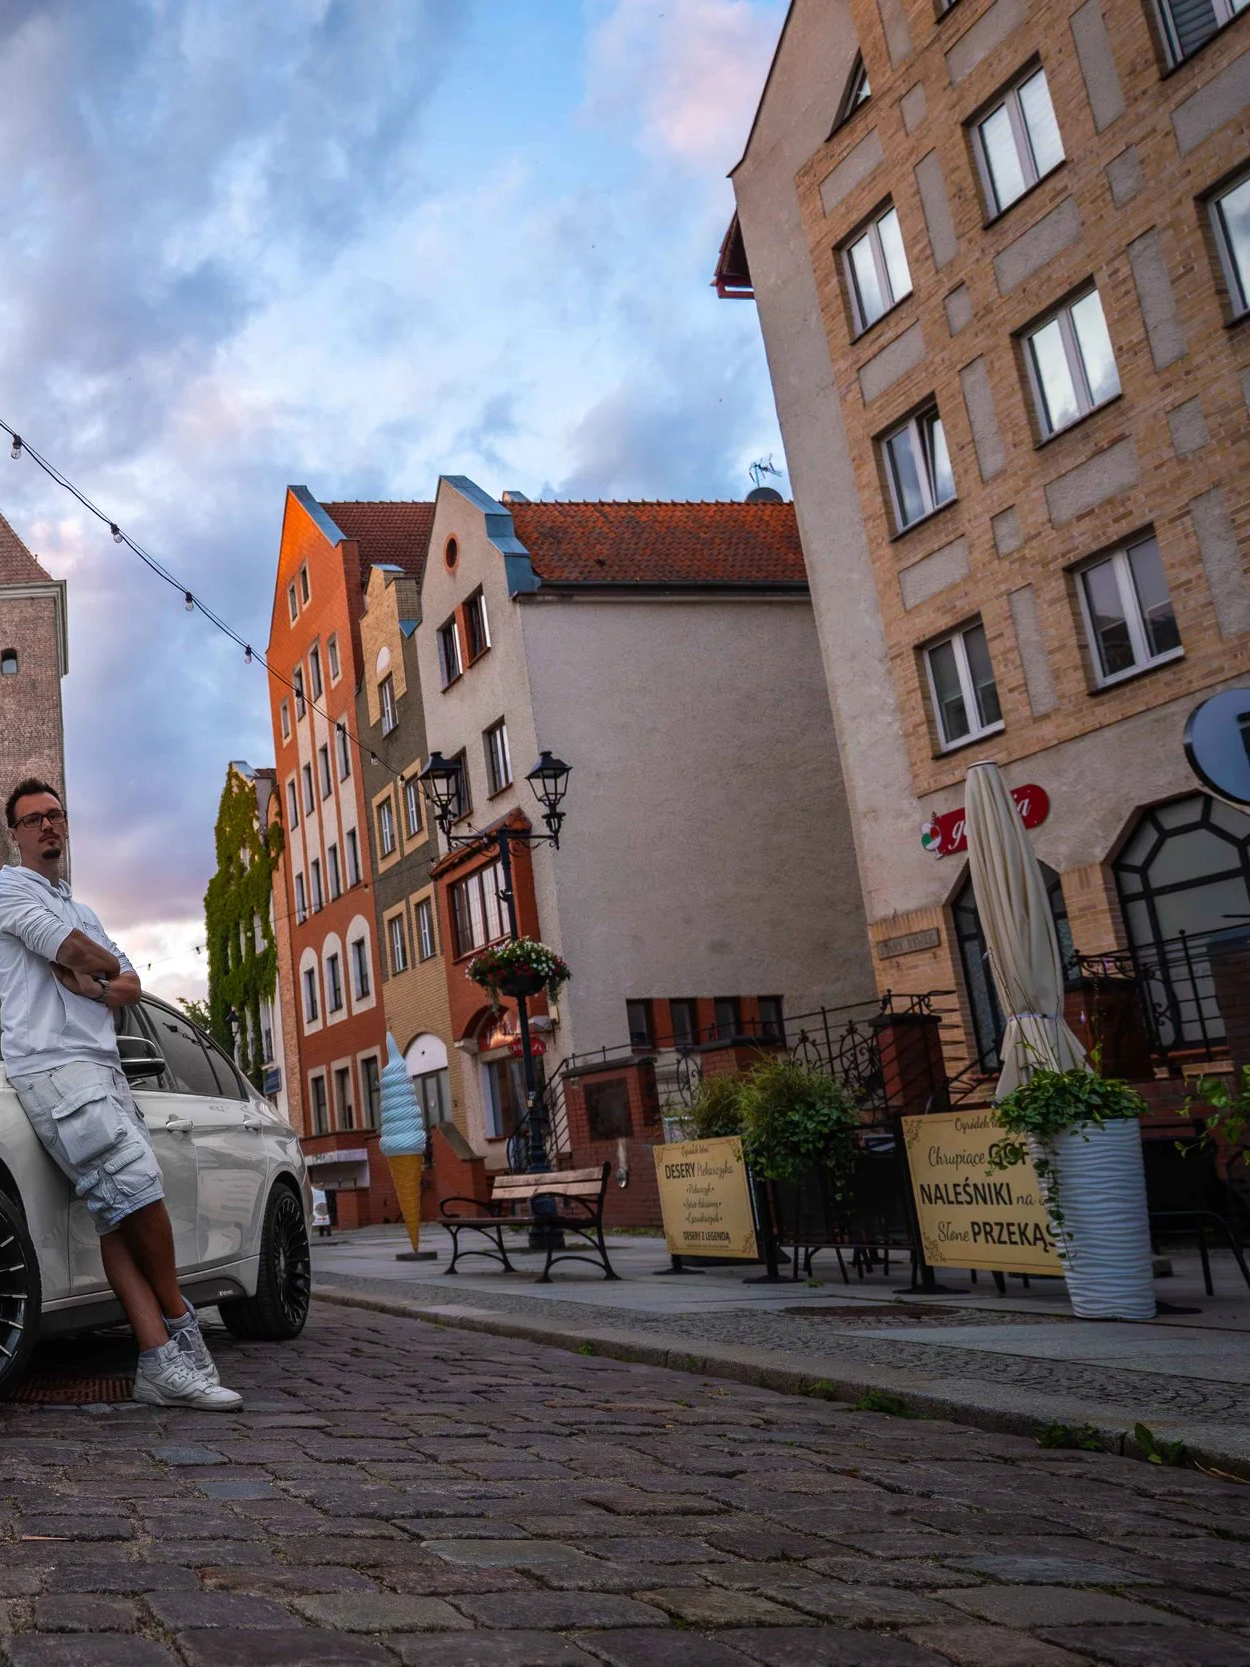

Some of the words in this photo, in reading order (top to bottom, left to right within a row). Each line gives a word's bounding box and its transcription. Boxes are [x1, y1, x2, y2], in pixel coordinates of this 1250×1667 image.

[954, 1116, 990, 1134] Ogródek
[928, 1146, 985, 1170] Chrupiące
[665, 1162, 695, 1179] DESERY
[919, 1177, 1013, 1206] NALEŚNIKI
[1016, 1193, 1034, 1206] na
[938, 1221, 971, 1243] Słone
